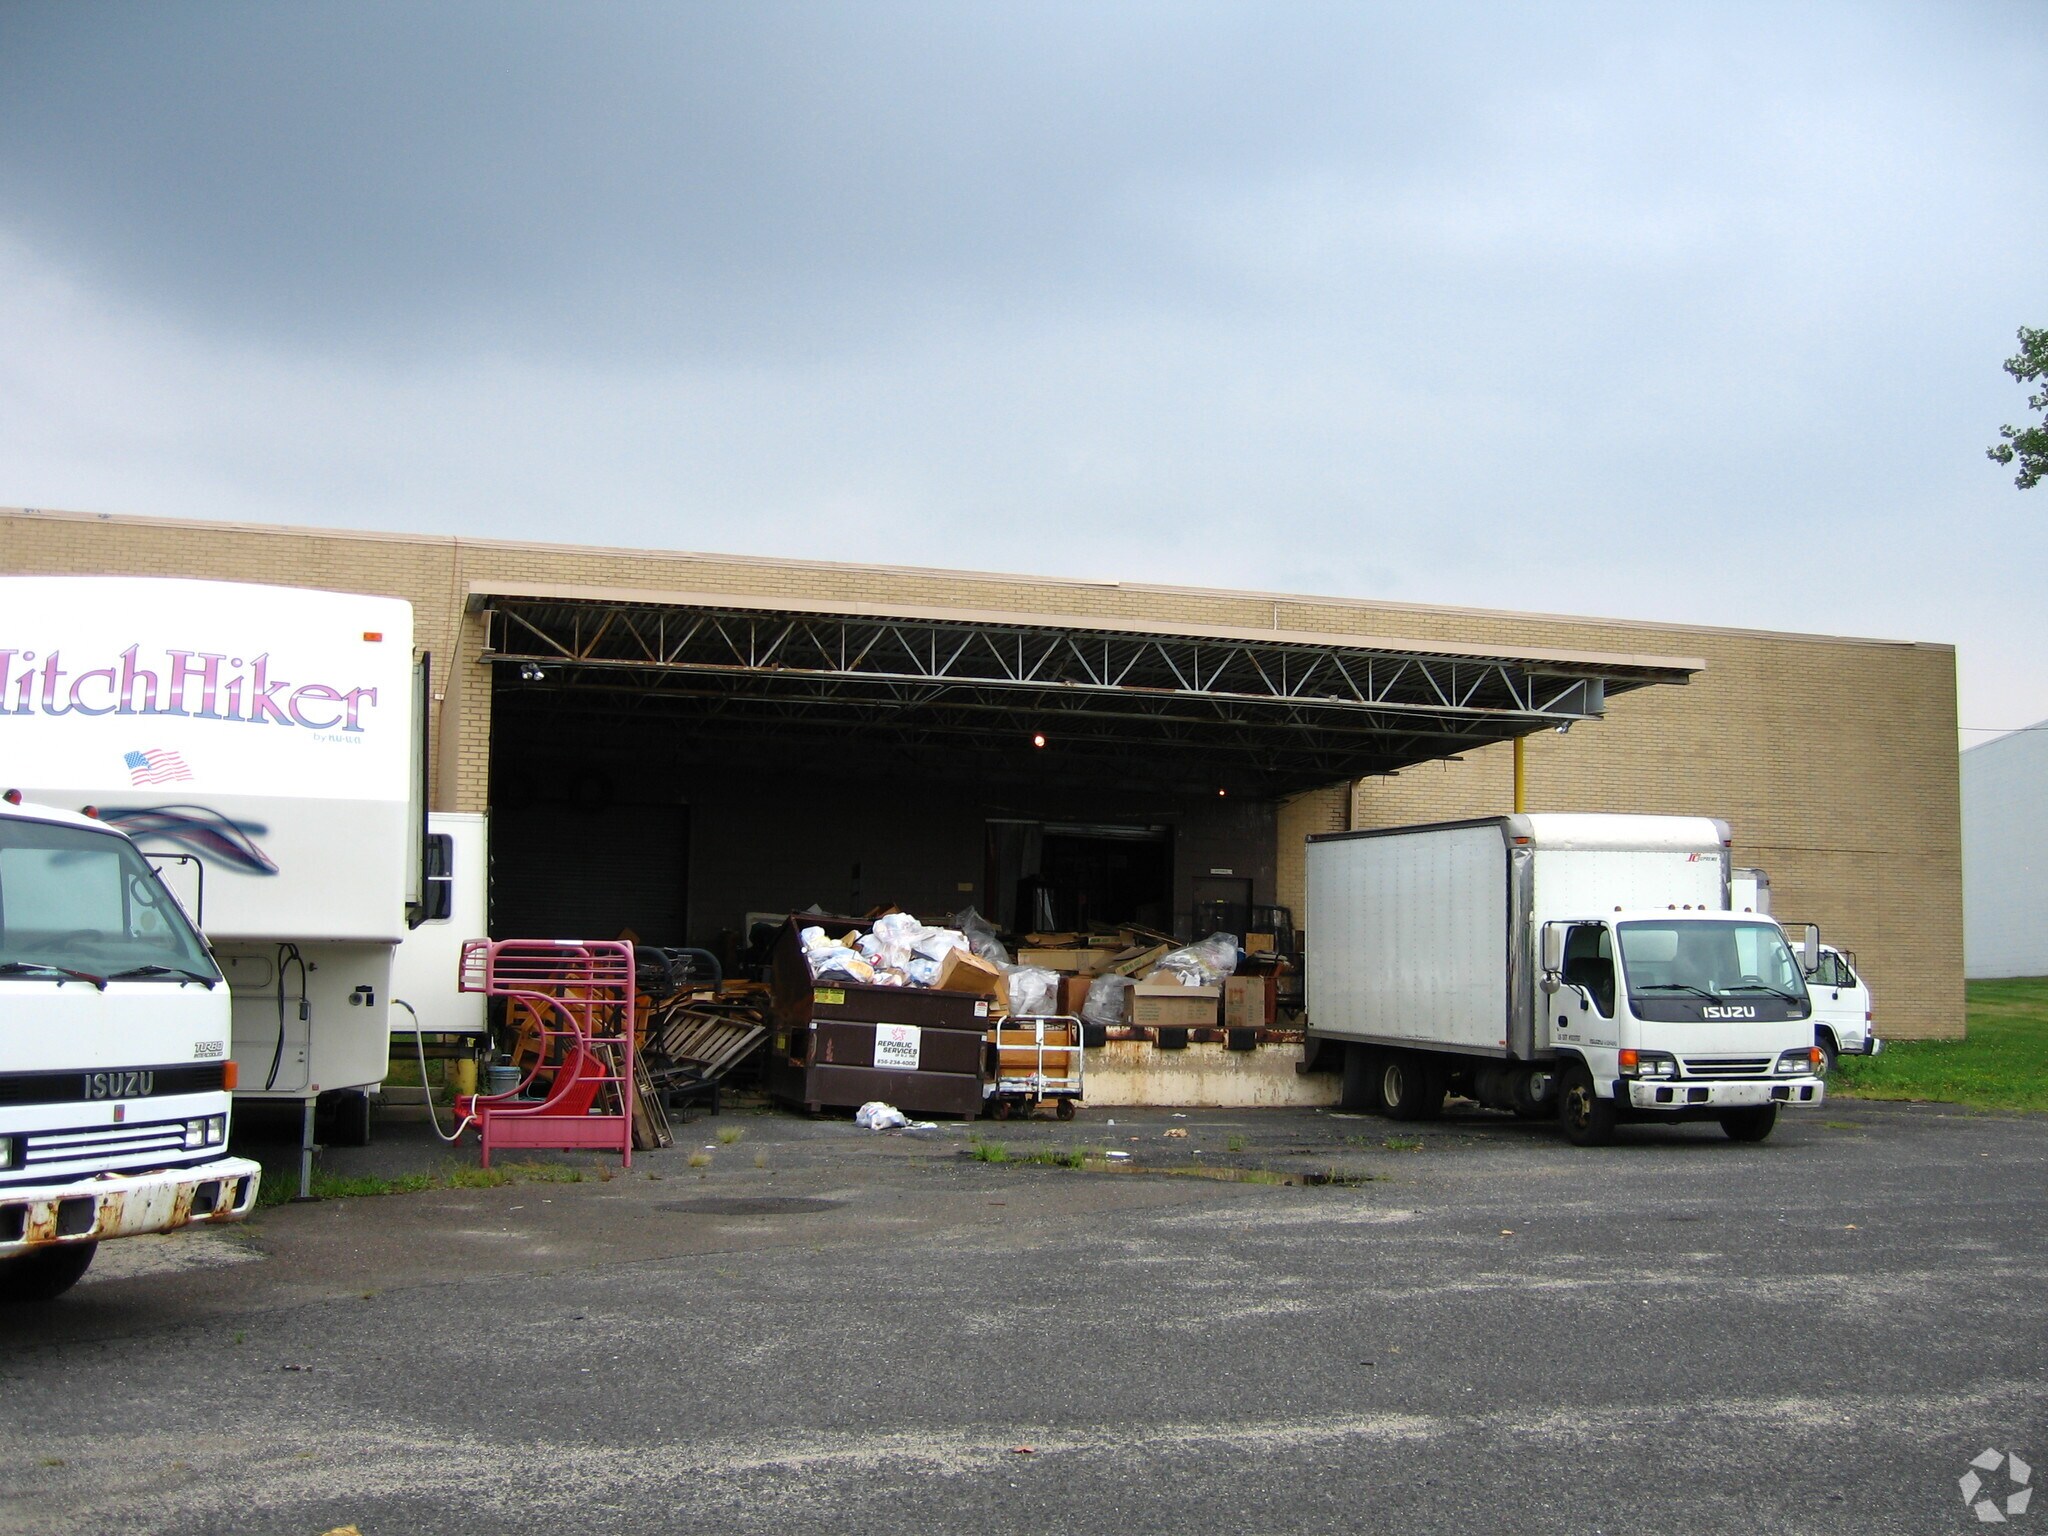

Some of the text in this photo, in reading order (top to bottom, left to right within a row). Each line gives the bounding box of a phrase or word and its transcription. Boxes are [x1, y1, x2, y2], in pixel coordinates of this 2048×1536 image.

[1702, 1006, 1756, 1018] ISUZU
[194, 1040, 224, 1053] TURBO
[877, 1040, 913, 1048] REPUBLIC
[882, 1047, 918, 1055] SERVICES
[84, 1071, 154, 1099] ISUZU
